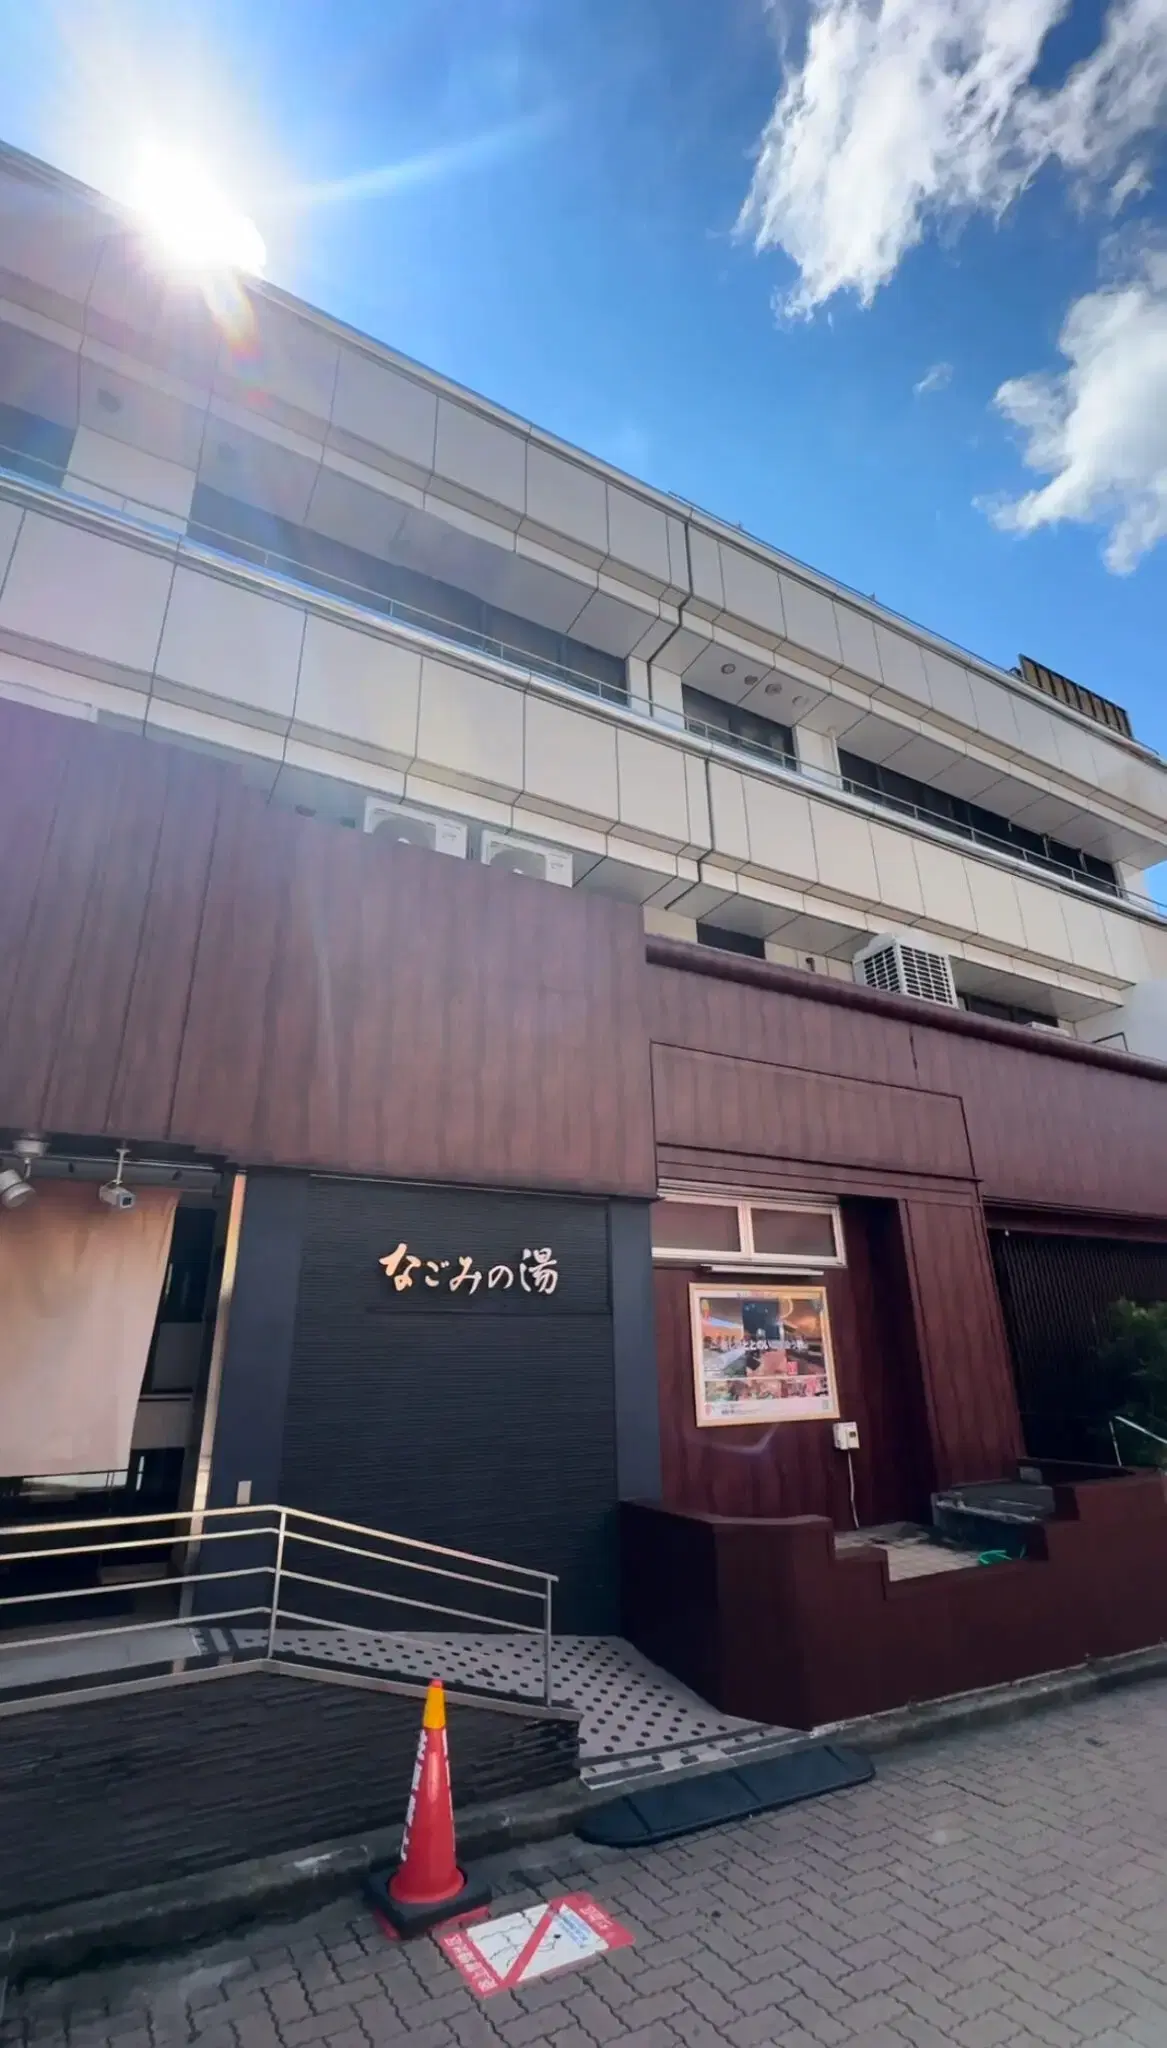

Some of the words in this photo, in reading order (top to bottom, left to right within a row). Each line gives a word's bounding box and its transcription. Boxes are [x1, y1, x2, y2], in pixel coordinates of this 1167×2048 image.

[378, 1242, 558, 1295] なごみの湯
